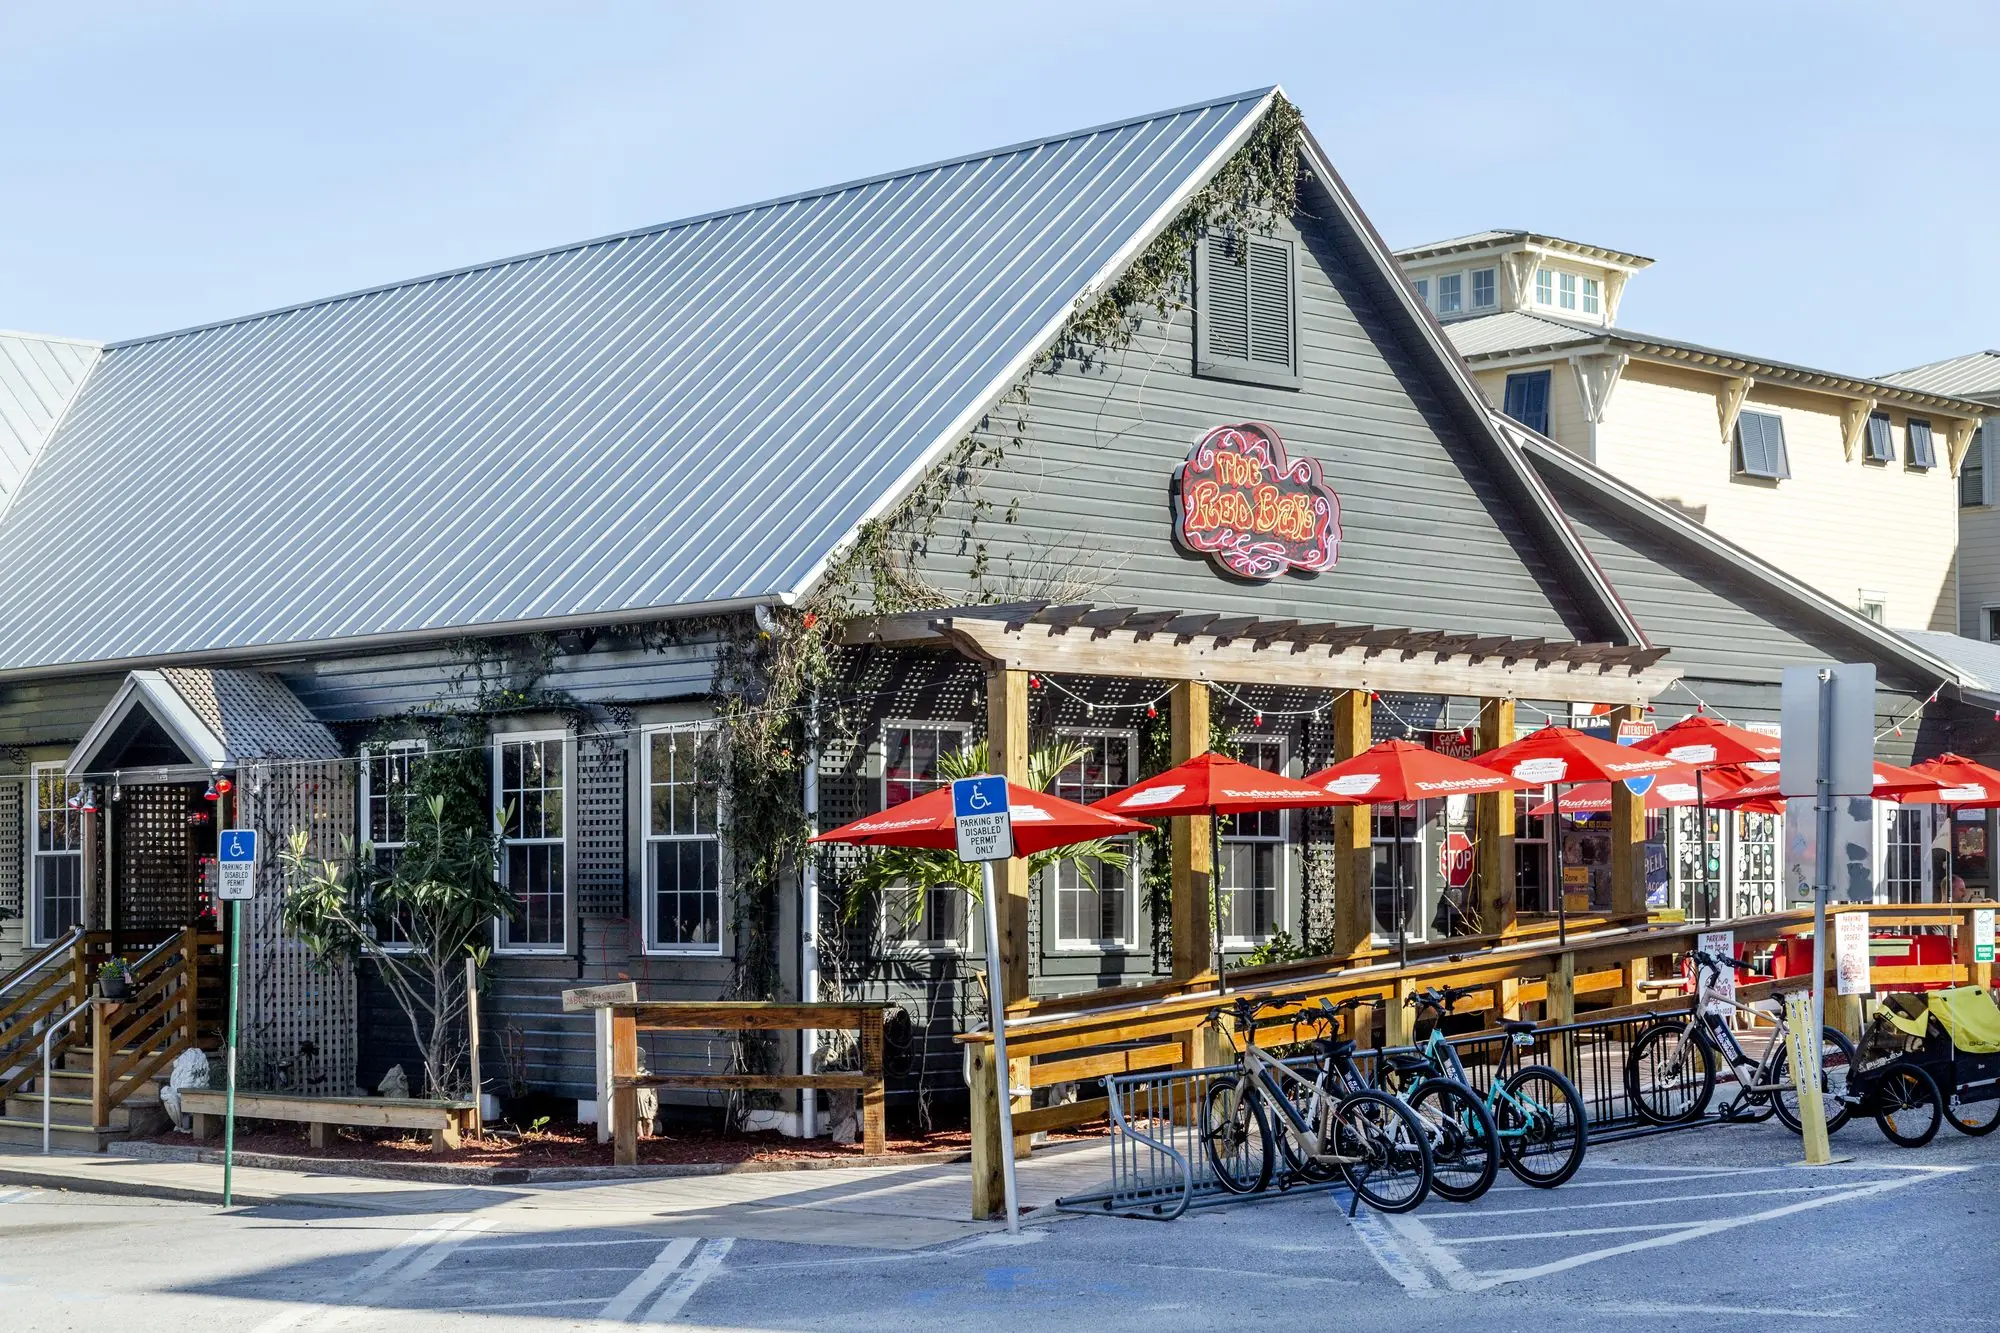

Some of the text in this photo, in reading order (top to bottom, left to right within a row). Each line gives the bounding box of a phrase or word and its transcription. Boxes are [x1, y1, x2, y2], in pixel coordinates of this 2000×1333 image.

[1622, 725, 1654, 735] INTERSTATE
[1415, 777, 1508, 791] Budweiser
[1221, 789, 1324, 797] Budweiser
[1558, 798, 1612, 807] Budweis
[960, 815, 1004, 828] PARKING BY
[965, 825, 1001, 837] DISABLED
[970, 835, 997, 846] PERMIT
[975, 845, 994, 855] ONLY
[1442, 849, 1472, 870] STOP
[221, 863, 243, 871] PARKING
[224, 871, 249, 879] DISABLED
[226, 879, 245, 887] PERMIT
[229, 887, 243, 895] ONLY
